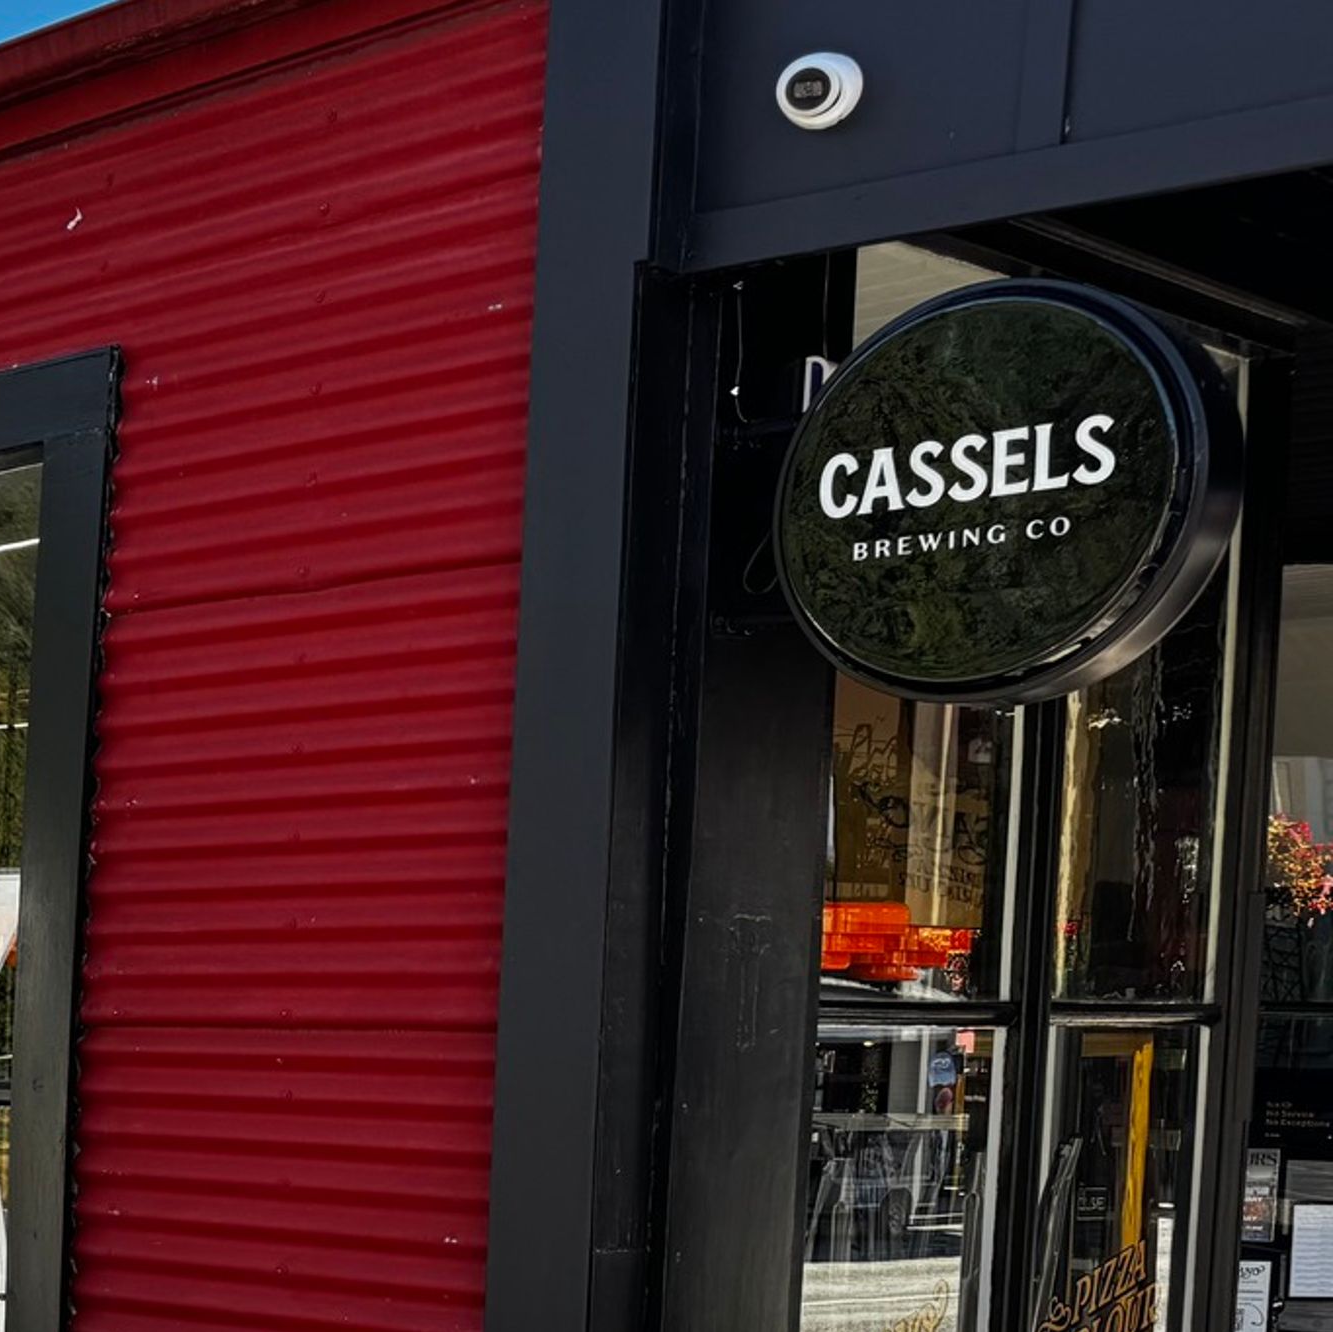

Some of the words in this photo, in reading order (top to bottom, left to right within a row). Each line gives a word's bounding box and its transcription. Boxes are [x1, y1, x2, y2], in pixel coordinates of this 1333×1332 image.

[819, 414, 1117, 519] CASSELS
[853, 525, 1007, 562] BREWING
[1026, 517, 1071, 540] CO
[1071, 1239, 1147, 1325] PIZZA
